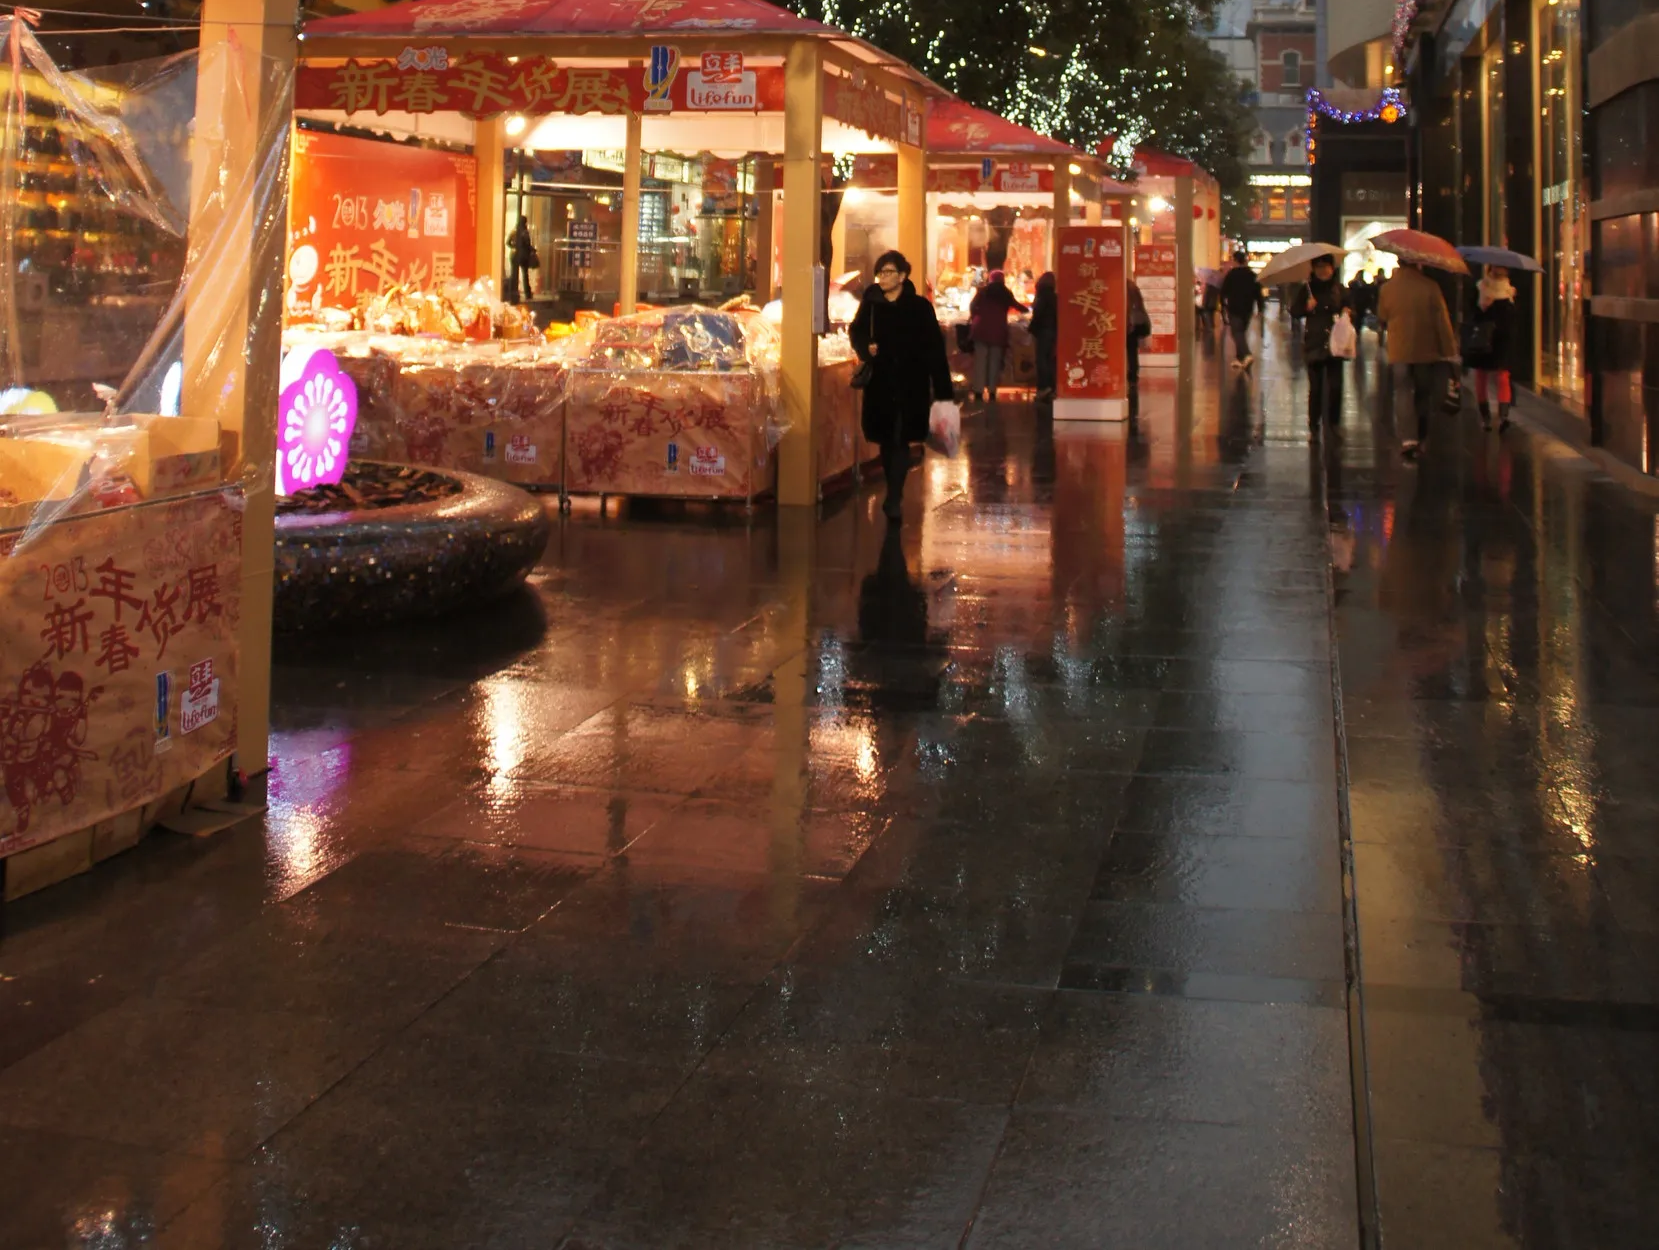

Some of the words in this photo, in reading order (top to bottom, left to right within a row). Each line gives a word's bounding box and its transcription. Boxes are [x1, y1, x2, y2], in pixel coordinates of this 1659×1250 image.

[398, 47, 447, 70] 久光
[703, 54, 741, 73] 立丰
[329, 57, 619, 116] 新春年货展
